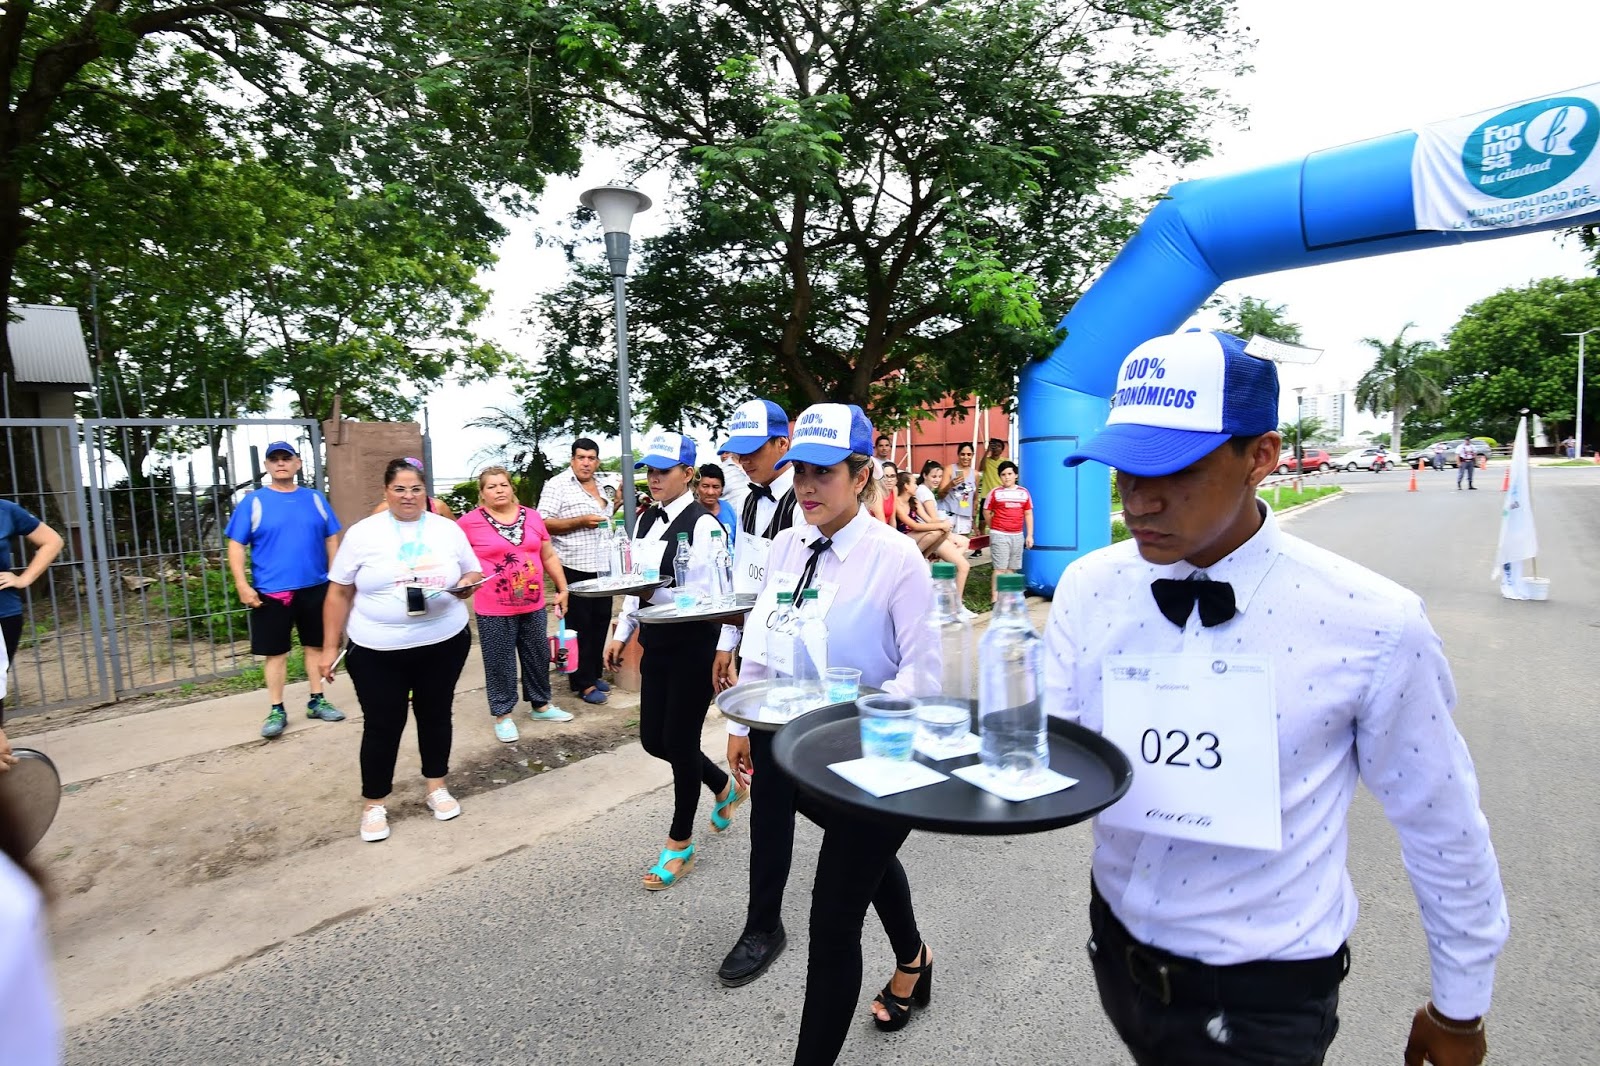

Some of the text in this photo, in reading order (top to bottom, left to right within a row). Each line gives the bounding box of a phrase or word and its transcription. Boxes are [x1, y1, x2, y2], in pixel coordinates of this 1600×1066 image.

[1483, 120, 1527, 144] For
[1482, 136, 1522, 157] mo
[1480, 152, 1512, 171] sa
[1480, 158, 1552, 184] tu ciudad
[1466, 184, 1590, 217] MUNICIPALIDAD DE
[1470, 213, 1515, 228] CIUDAD
[1518, 208, 1535, 219] DE
[1539, 194, 1600, 216] FORMOS
[1124, 357, 1166, 381] 100%
[800, 413, 823, 425] 100%
[1141, 728, 1222, 769] 023
